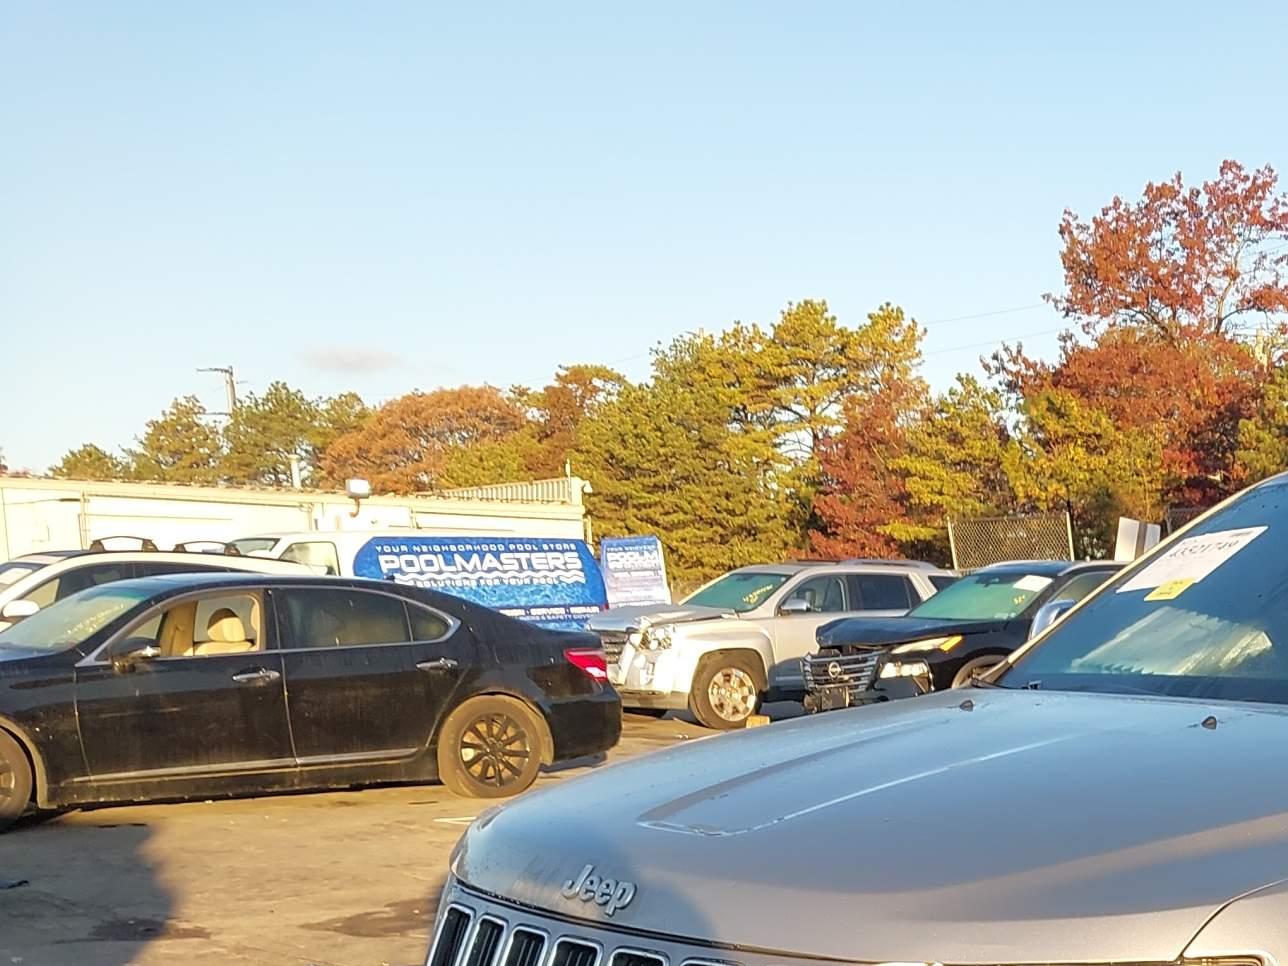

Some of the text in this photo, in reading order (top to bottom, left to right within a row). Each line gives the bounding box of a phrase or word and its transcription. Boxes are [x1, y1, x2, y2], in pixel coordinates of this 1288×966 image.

[375, 543, 577, 553] YOUR NEIGHBORHOOD POOL STORE
[378, 551, 584, 573] POOLMASTERS
[529, 607, 566, 616] SERVICE
[569, 605, 600, 615] REPAIR
[561, 864, 636, 917] Jeep
